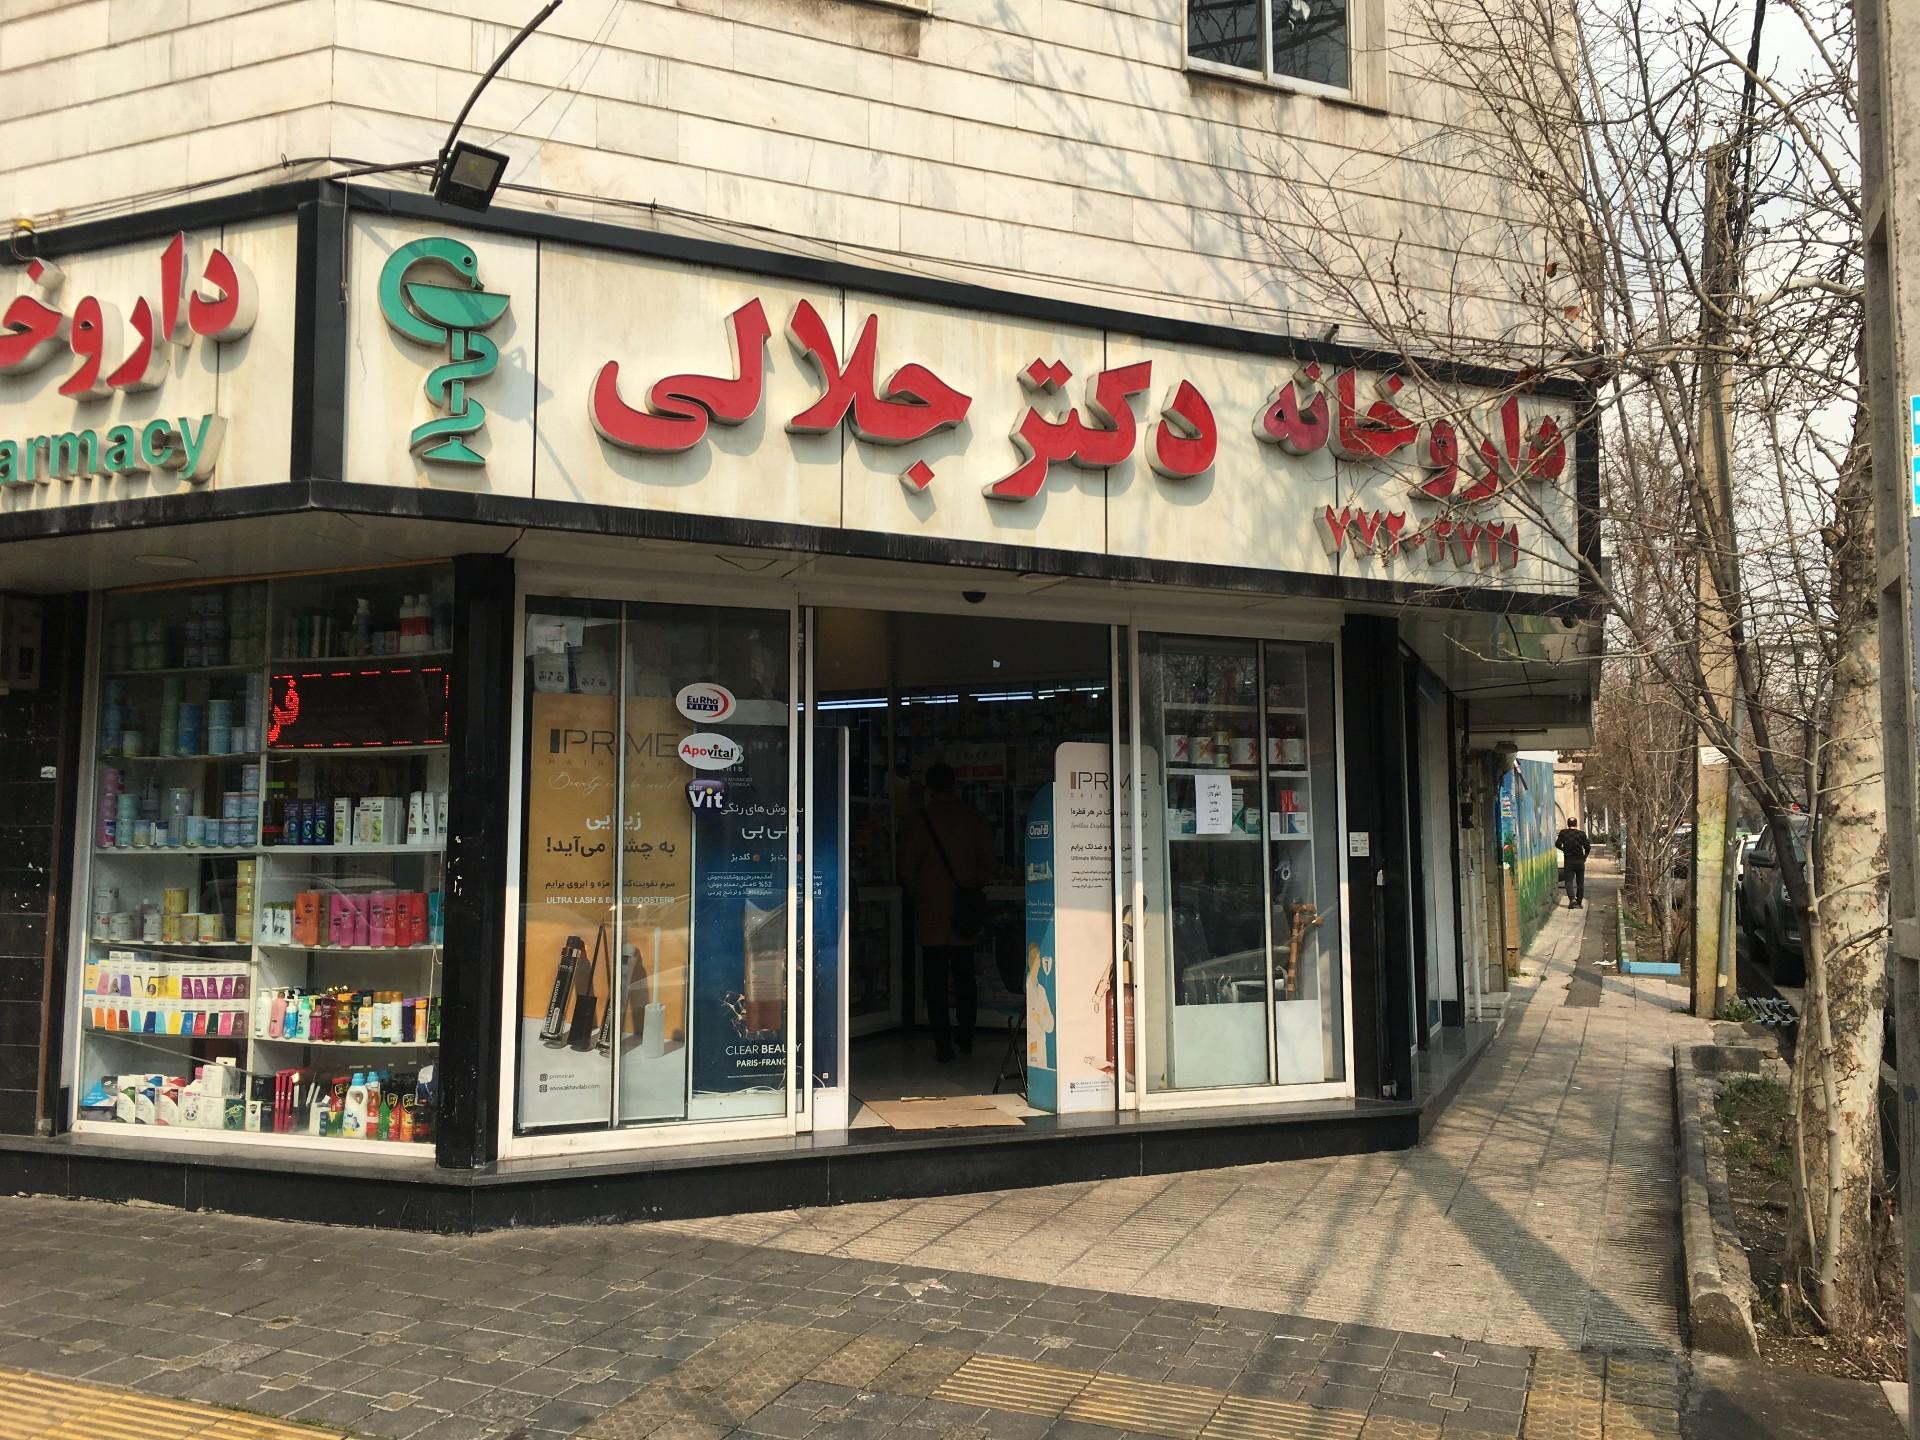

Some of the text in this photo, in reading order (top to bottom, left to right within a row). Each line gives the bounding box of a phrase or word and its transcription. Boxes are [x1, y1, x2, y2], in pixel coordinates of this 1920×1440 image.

[594, 297, 1566, 500] داروخانه دکتر جلالی
[563, 729, 680, 758] PRME
[681, 744, 735, 758] Apovital
[1078, 771, 1147, 791] PRME
[689, 787, 724, 809] Vit
[720, 802, 744, 816] رنگی
[745, 803, 765, 816] های
[741, 825, 764, 840] بی
[658, 839, 676, 857] به
[546, 896, 573, 904] ULTRA
[574, 896, 596, 904] LASH
[597, 896, 604, 904] &
[725, 1042, 802, 1056] CLEAR BEAUY
[736, 1057, 787, 1068] PARIS-FRANC
